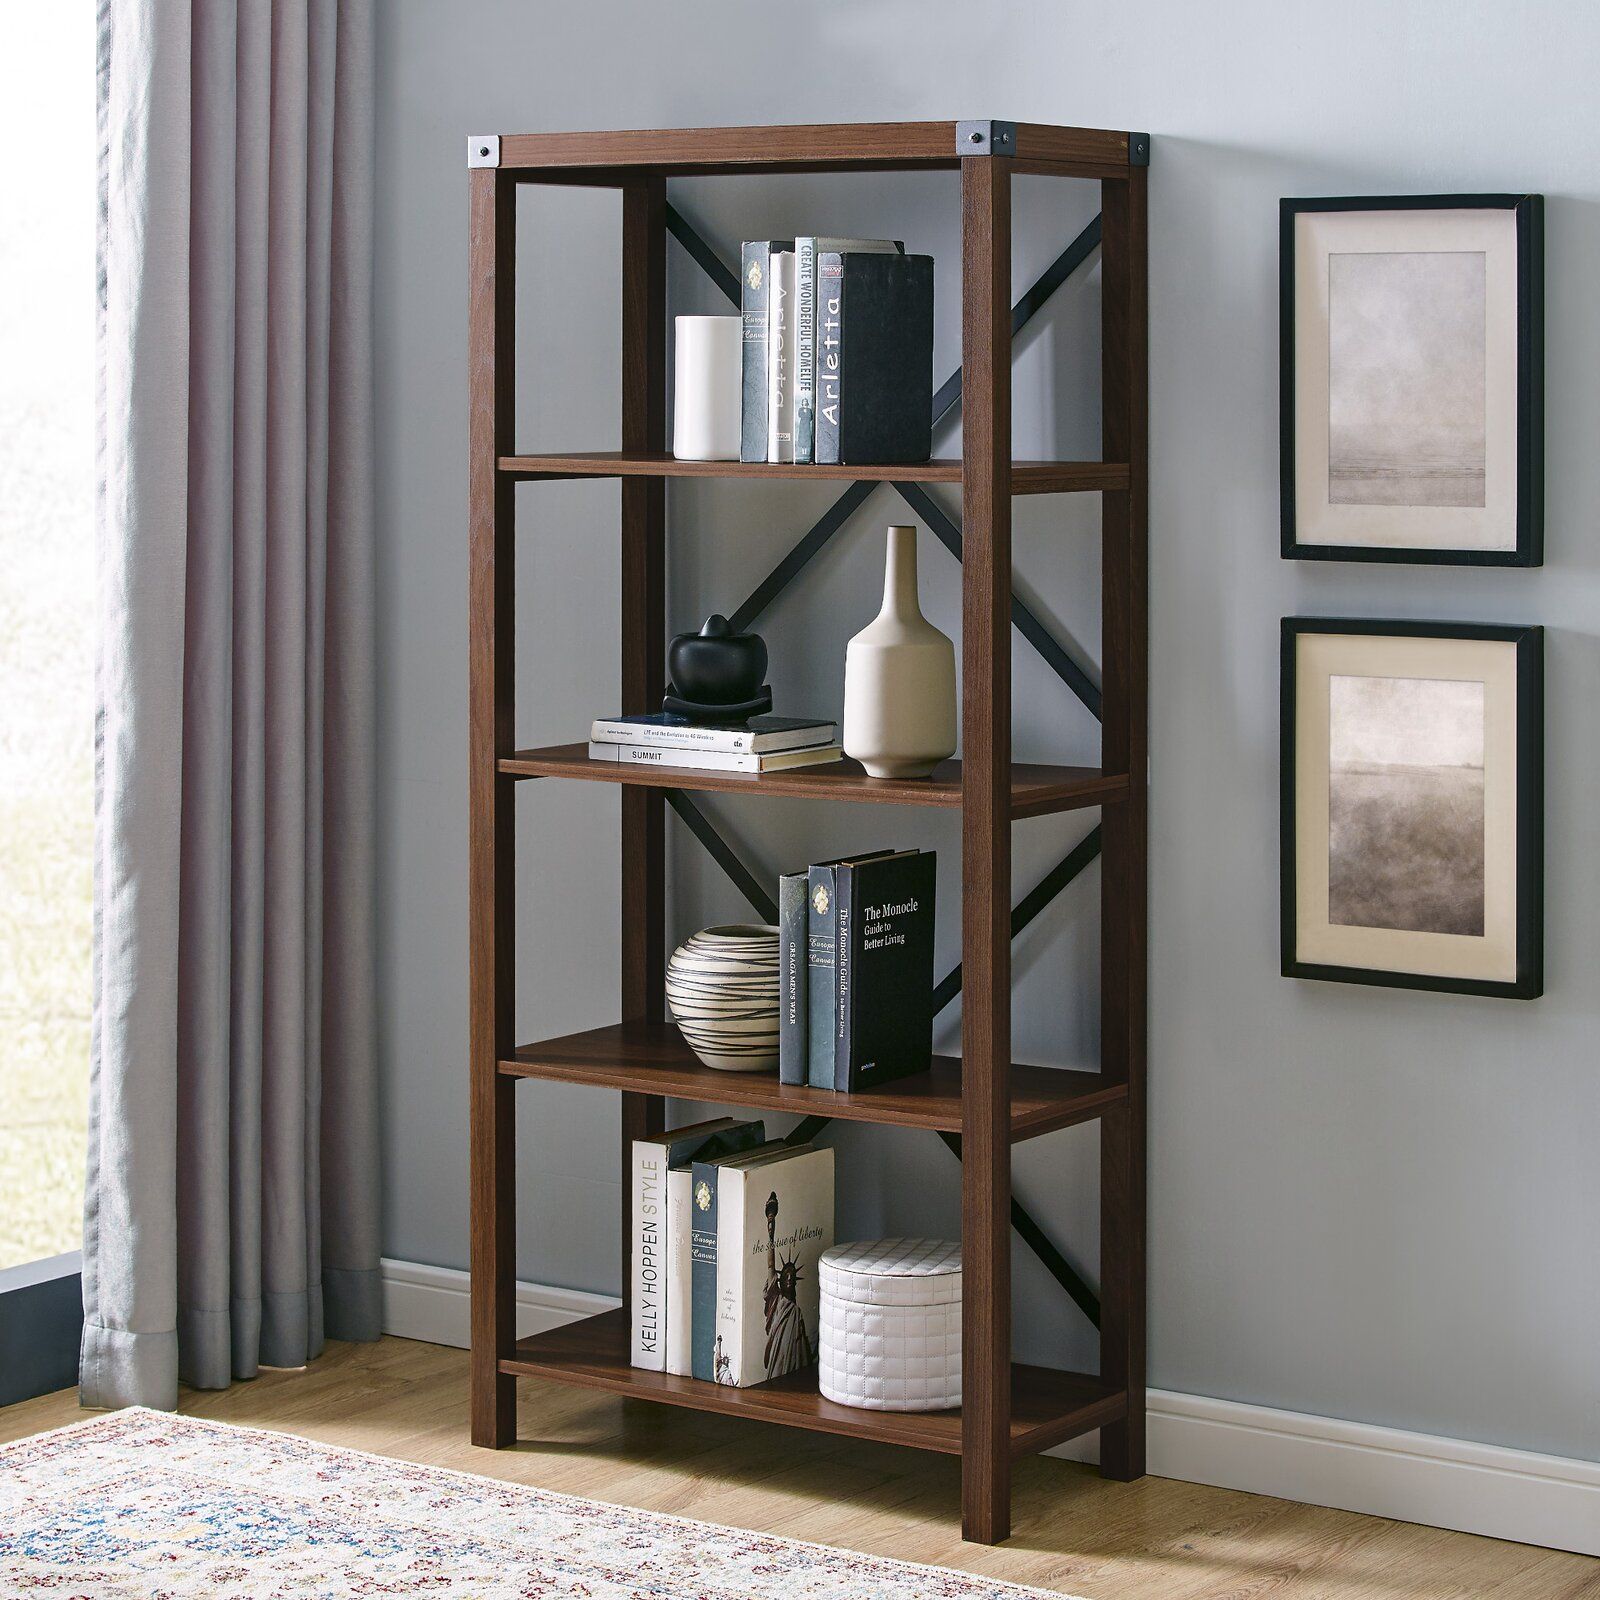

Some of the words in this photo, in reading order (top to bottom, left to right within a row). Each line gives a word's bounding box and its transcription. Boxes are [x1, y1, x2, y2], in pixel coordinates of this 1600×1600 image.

[801, 245, 812, 279] CREATE
[800, 282, 812, 341] WONDERFUL
[800, 343, 812, 391] HOMELIFE
[821, 298, 840, 426] Arletta
[632, 751, 662, 760] SUMMIT
[840, 908, 848, 926] The
[864, 907, 881, 921] The
[882, 897, 919, 918] Monocle
[864, 922, 883, 936] Guide
[884, 923, 892, 932] to
[864, 937, 884, 950] Better
[885, 933, 905, 945] Living
[810, 938, 835, 950] Europe
[840, 927, 848, 967] Monocle
[809, 954, 835, 965] Canvas
[840, 968, 848, 996] Guide
[642, 1160, 657, 1215] STYLE
[692, 1233, 716, 1246] Europe
[752, 1240, 764, 1255] the
[765, 1237, 787, 1250] stue
[789, 1229, 798, 1248] of
[799, 1225, 823, 1242] liberty
[642, 1221, 657, 1294] HOPPEN
[692, 1249, 716, 1260] Canvas
[641, 1299, 657, 1353] KELLY
